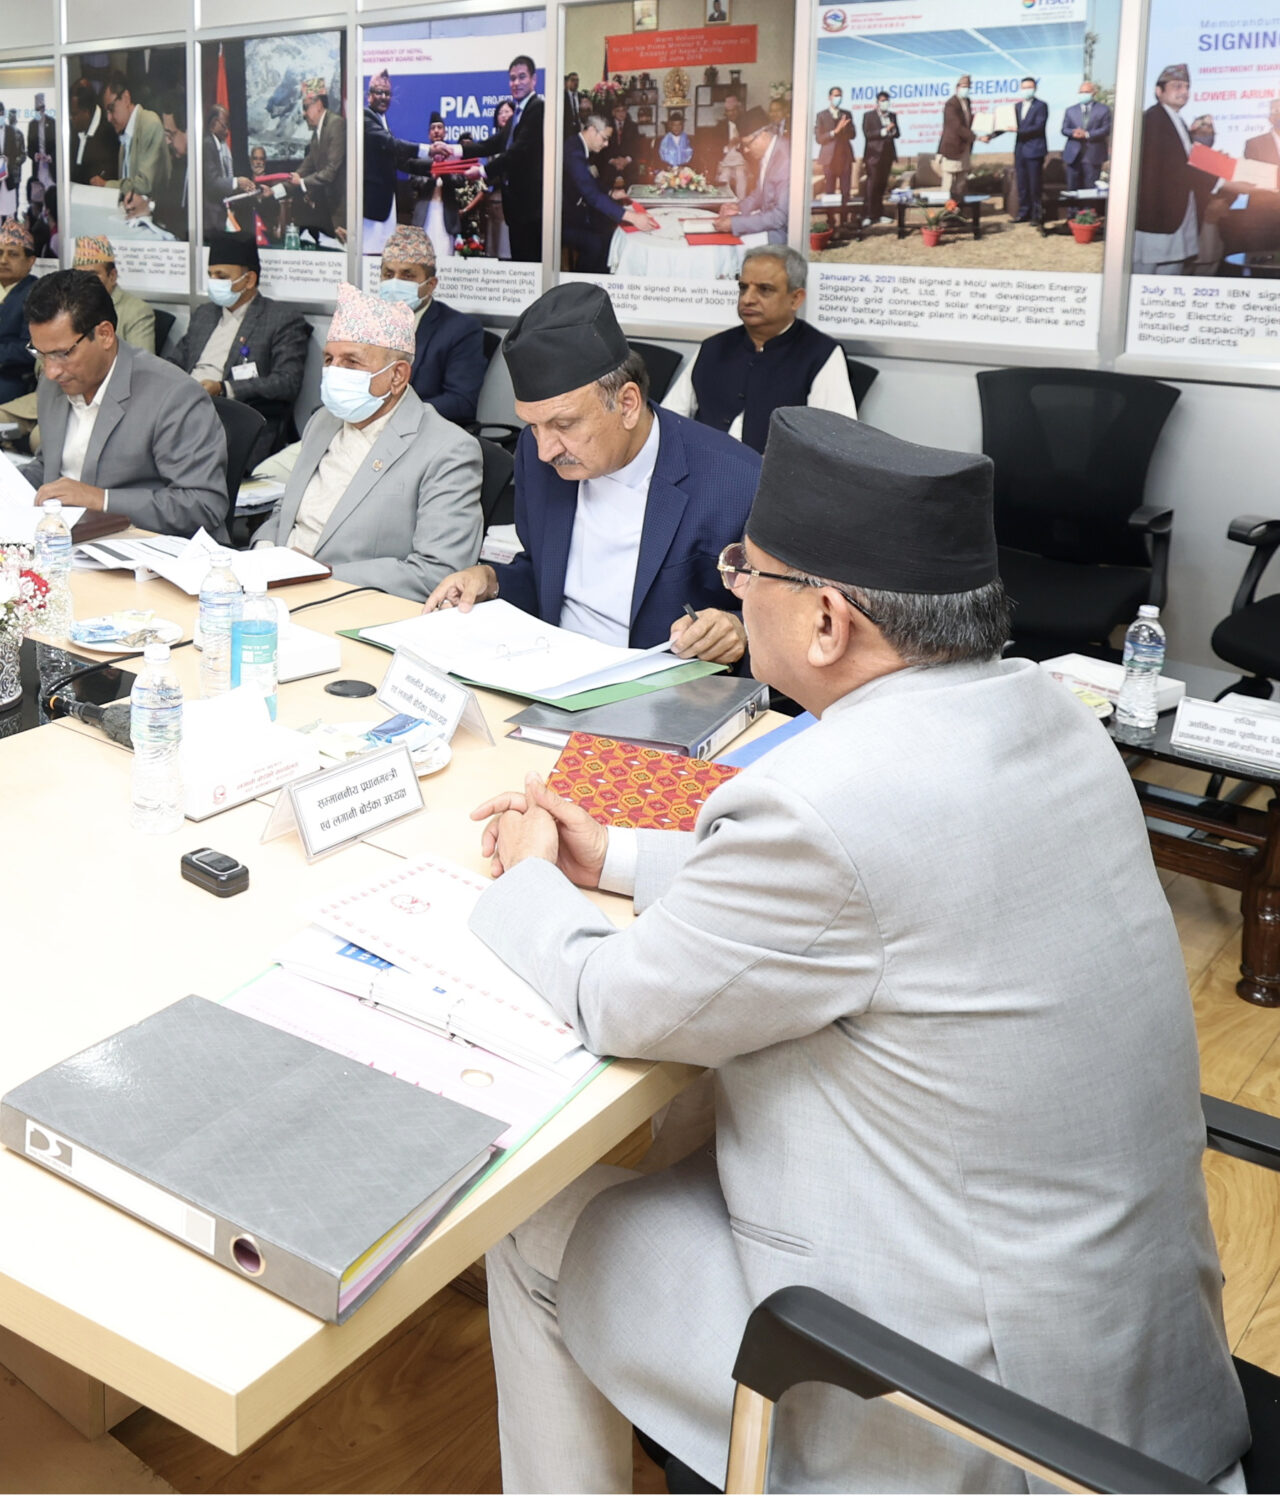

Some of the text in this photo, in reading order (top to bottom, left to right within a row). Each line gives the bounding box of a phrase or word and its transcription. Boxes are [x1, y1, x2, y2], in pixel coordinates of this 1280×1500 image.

[1198, 31, 1280, 52] SIGNIN
[1200, 64, 1254, 74] INVESTMENT
[889, 83, 950, 99] SIGNING
[1194, 88, 1275, 102] LOWER ARUN
[440, 96, 480, 118] PIA
[454, 267, 480, 276] Hongshi
[482, 268, 506, 276] Shivam
[481, 277, 517, 286] Agreement
[820, 272, 856, 283] January
[860, 274, 872, 282] 26,
[876, 275, 896, 283] 2021
[898, 276, 916, 284] IBN
[918, 277, 952, 286] signed
[964, 280, 987, 288] MoU
[990, 280, 1013, 288] with
[1016, 282, 1044, 290] Risen
[1049, 283, 1088, 294] Energy
[502, 287, 526, 295] project
[644, 285, 670, 294] signed
[674, 286, 687, 294] PIA
[819, 283, 865, 293] Singapore
[996, 292, 1066, 302] development
[1075, 296, 1087, 304] of
[1142, 285, 1166, 296] July
[1193, 288, 1220, 296] 2021
[1227, 290, 1250, 298] IBN
[460, 293, 488, 302] Province
[643, 295, 693, 304] development
[705, 298, 724, 306] 3000
[818, 294, 859, 303] 250MWp
[864, 296, 884, 304] grid
[888, 297, 940, 308] connected
[975, 304, 1010, 313] energy
[1016, 305, 1054, 314] project
[1140, 298, 1236, 310] Limited for the
[818, 314, 867, 324] Banganga,
[852, 306, 886, 316] battery
[889, 309, 925, 318] storage
[929, 310, 954, 320] plant
[1025, 316, 1060, 326] Banke
[1064, 318, 1086, 326] and
[1140, 310, 1232, 322] Hydro Electric
[1138, 322, 1190, 332] installed
[1138, 333, 1238, 347] Bhojpur districts
[318, 768, 398, 809] सम्माननीय प्रधानमन्त्री
[332, 806, 358, 827] लगानी
[360, 798, 382, 814] बोर्डका
[384, 788, 406, 805] अध्यक्ष
